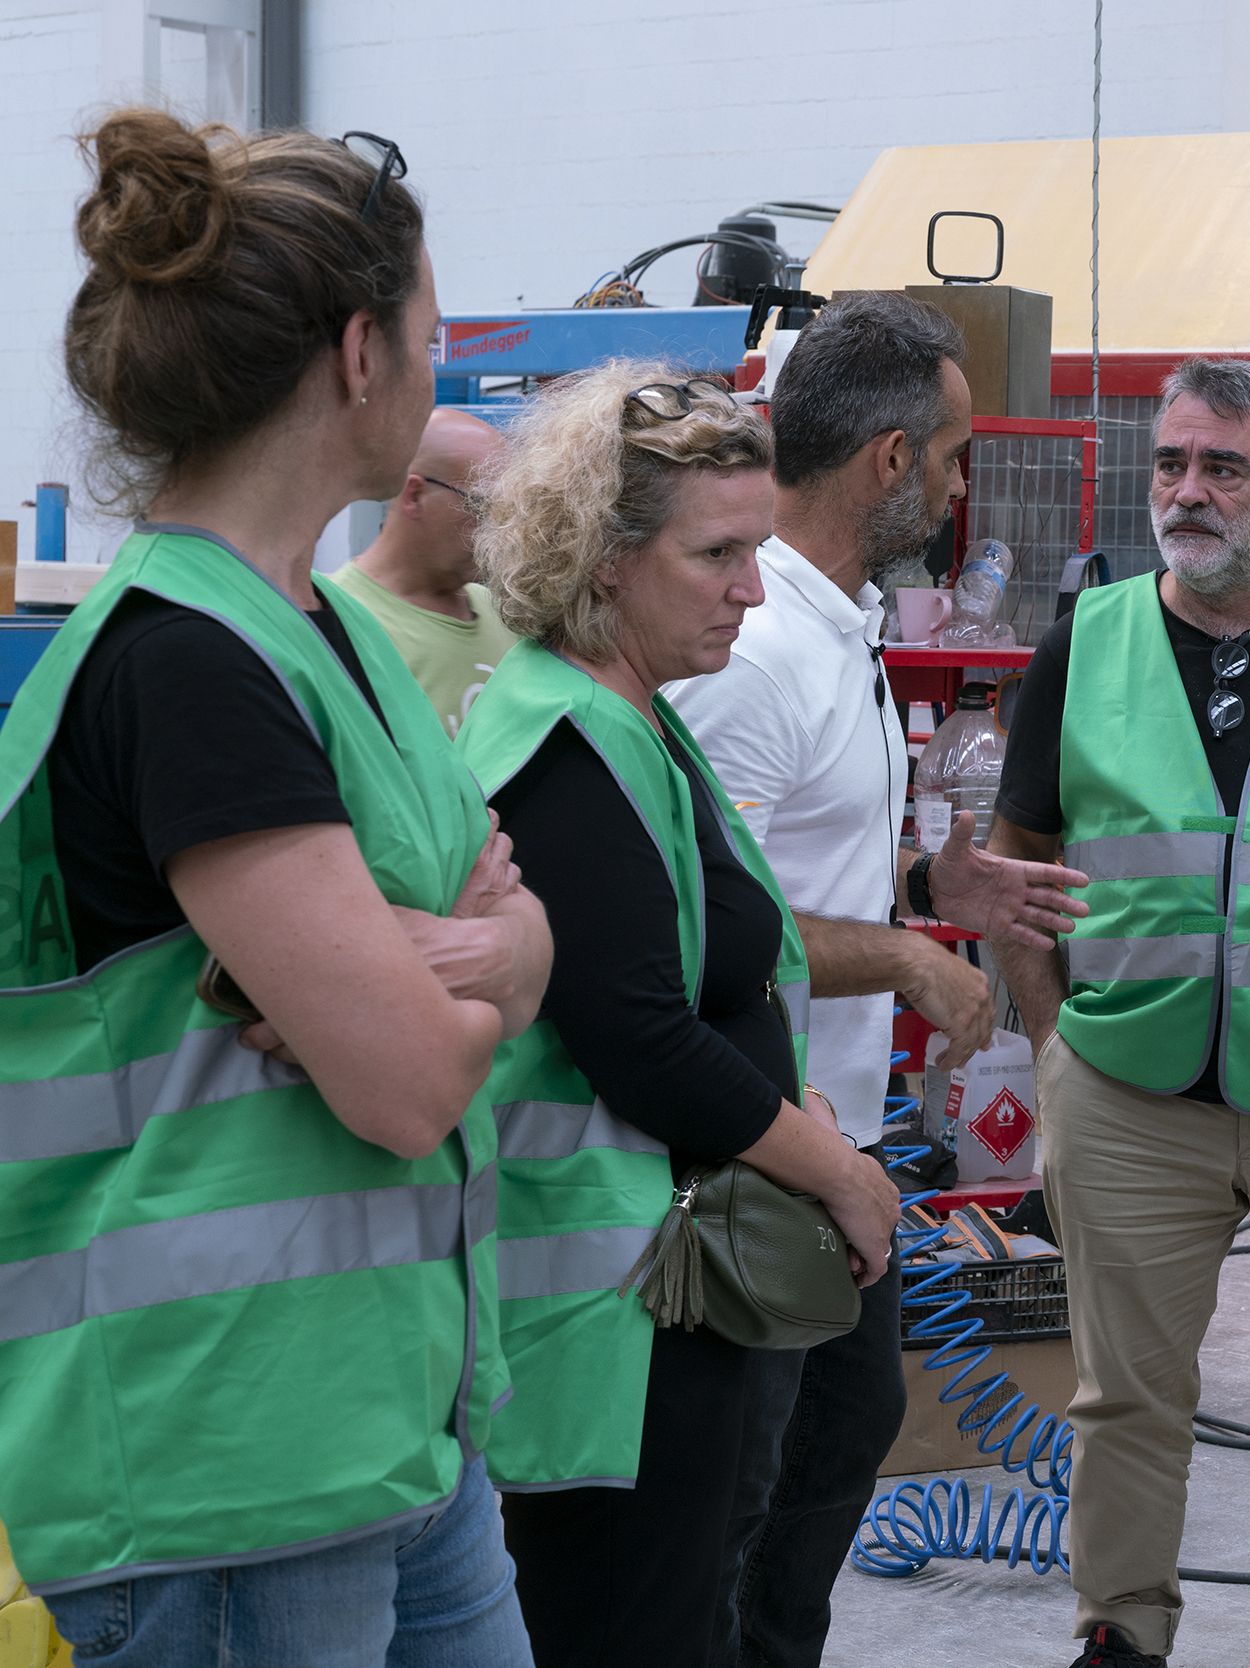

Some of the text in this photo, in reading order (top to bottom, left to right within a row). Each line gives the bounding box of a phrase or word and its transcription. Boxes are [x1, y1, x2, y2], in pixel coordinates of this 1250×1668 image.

[451, 329, 530, 361] Hundegger
[1001, 1147, 1008, 1156] 3
[817, 1226, 836, 1252] PO
